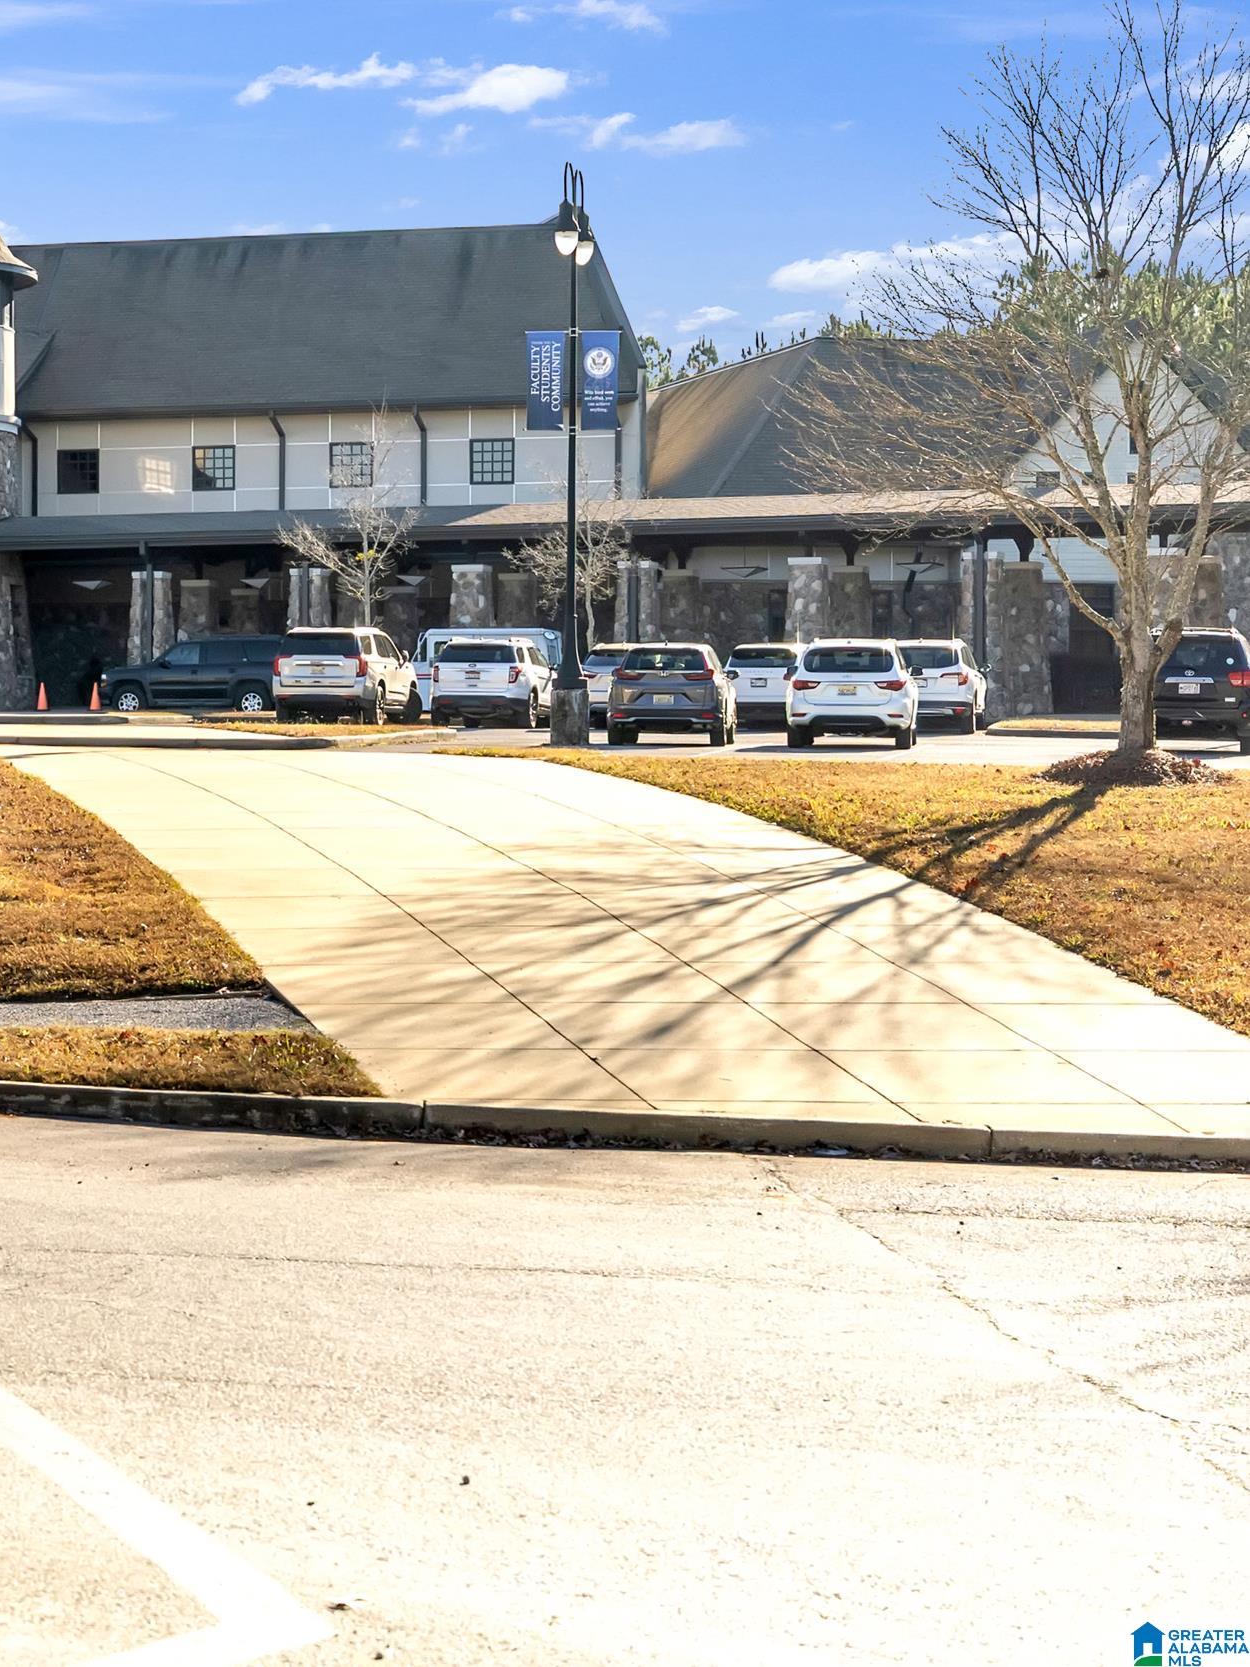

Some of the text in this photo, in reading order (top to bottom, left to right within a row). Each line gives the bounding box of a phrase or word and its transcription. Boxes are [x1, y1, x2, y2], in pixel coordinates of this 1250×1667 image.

[530, 345, 540, 395] FACULTY
[540, 345, 550, 403] STUDENTS
[551, 341, 561, 412] COMMUNITY
